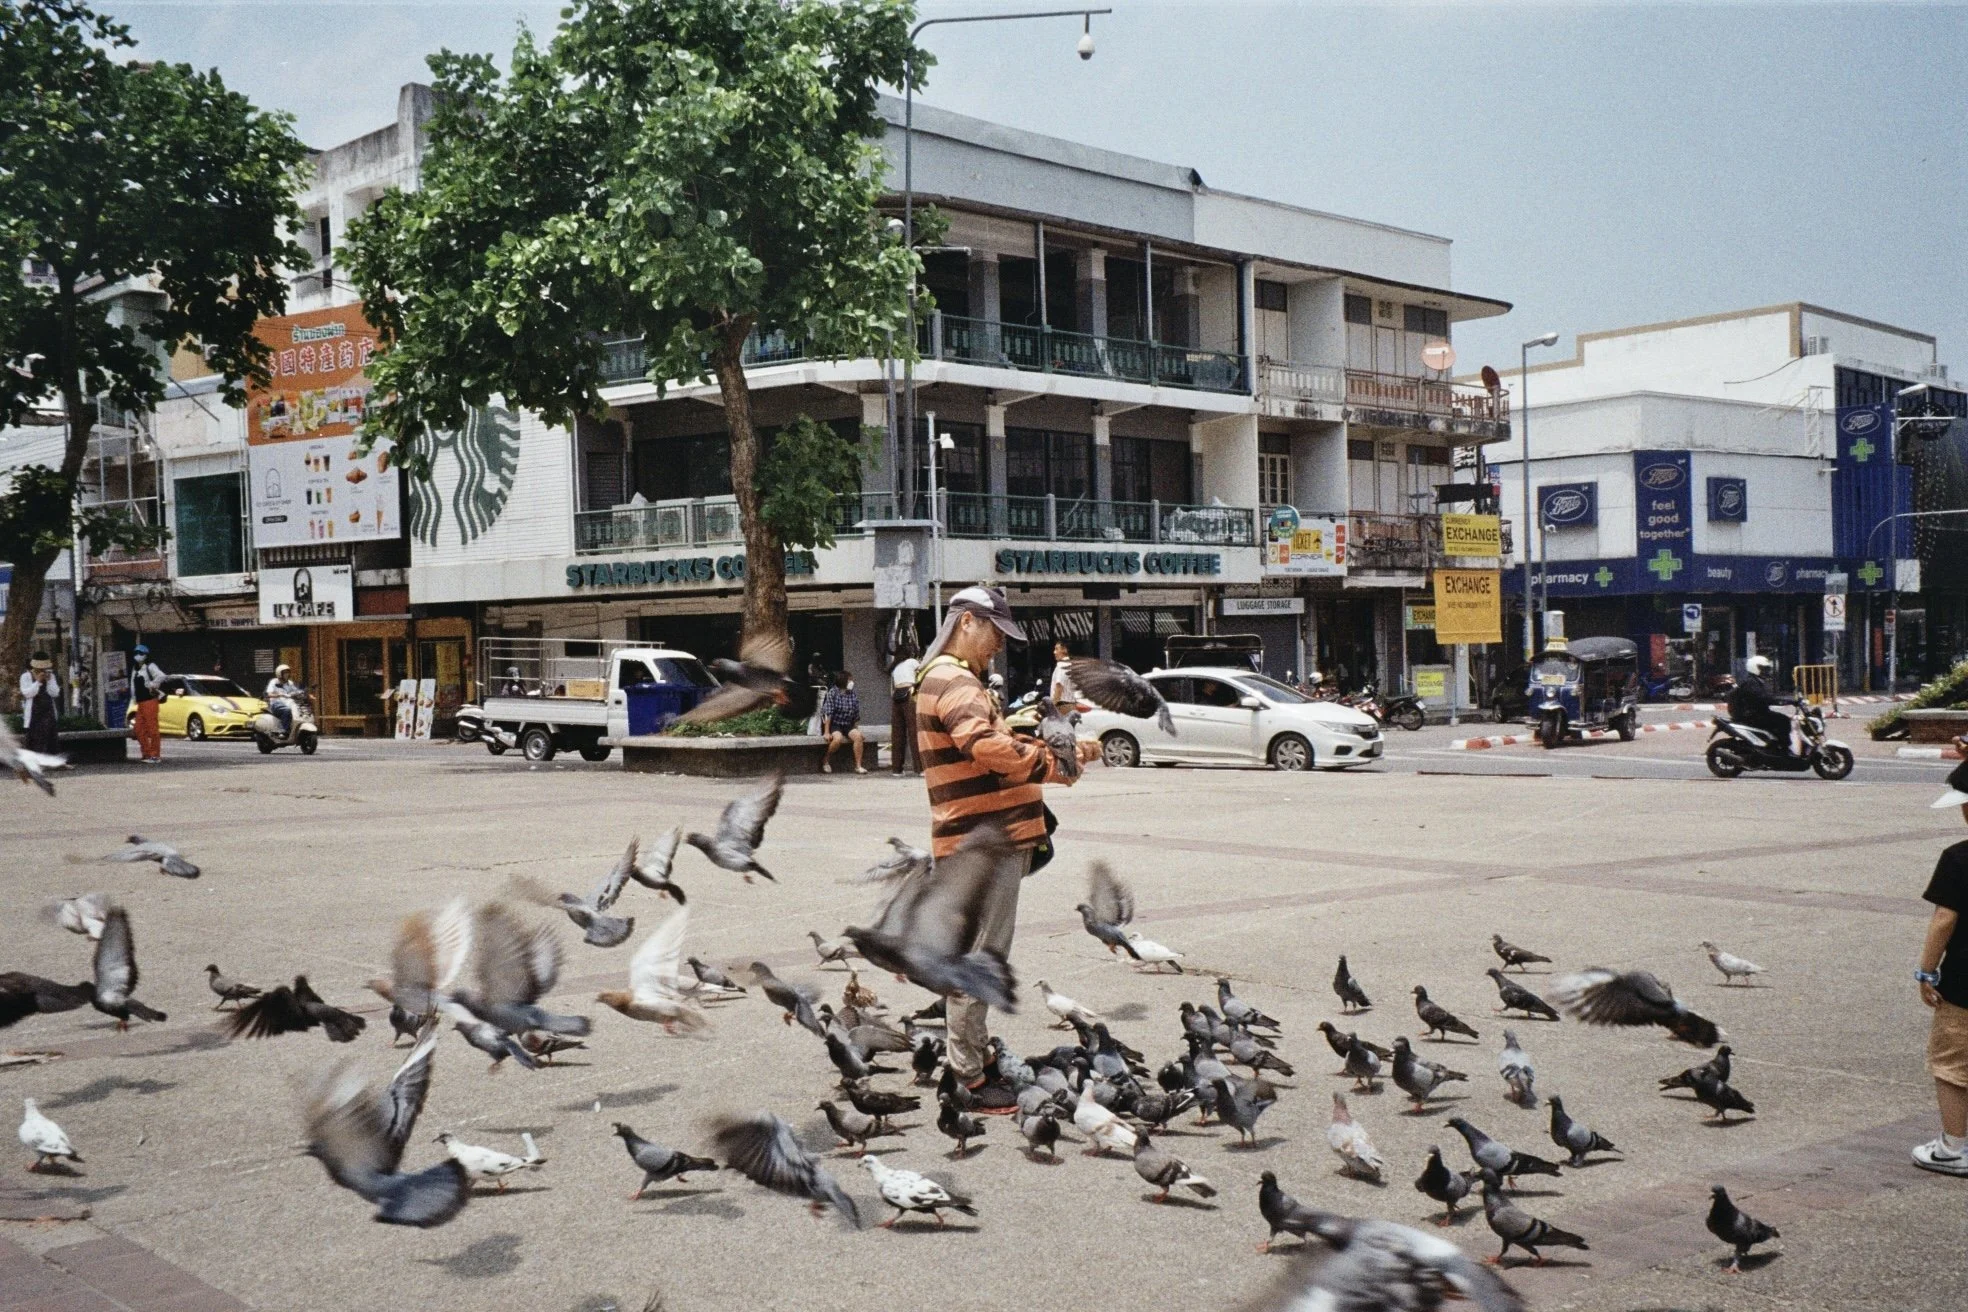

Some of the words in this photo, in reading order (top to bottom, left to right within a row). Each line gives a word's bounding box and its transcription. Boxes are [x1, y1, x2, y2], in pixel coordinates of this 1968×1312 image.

[1551, 495, 1582, 516] Boots
[1652, 500, 1675, 510] feel
[1648, 513, 1679, 525] good
[1446, 526, 1499, 542] EXCHANGE
[566, 557, 715, 588] STARBUCKS
[716, 551, 814, 579] COEE
[995, 550, 1140, 574] STARBUCKS
[1143, 553, 1221, 575] COFFEE
[1707, 567, 1732, 581] beauty
[1445, 576, 1491, 594] EXCHANGE
[296, 601, 336, 617] CAFE
[1237, 600, 1265, 610] LUGGAGE
[1267, 600, 1292, 609] STORAGE
